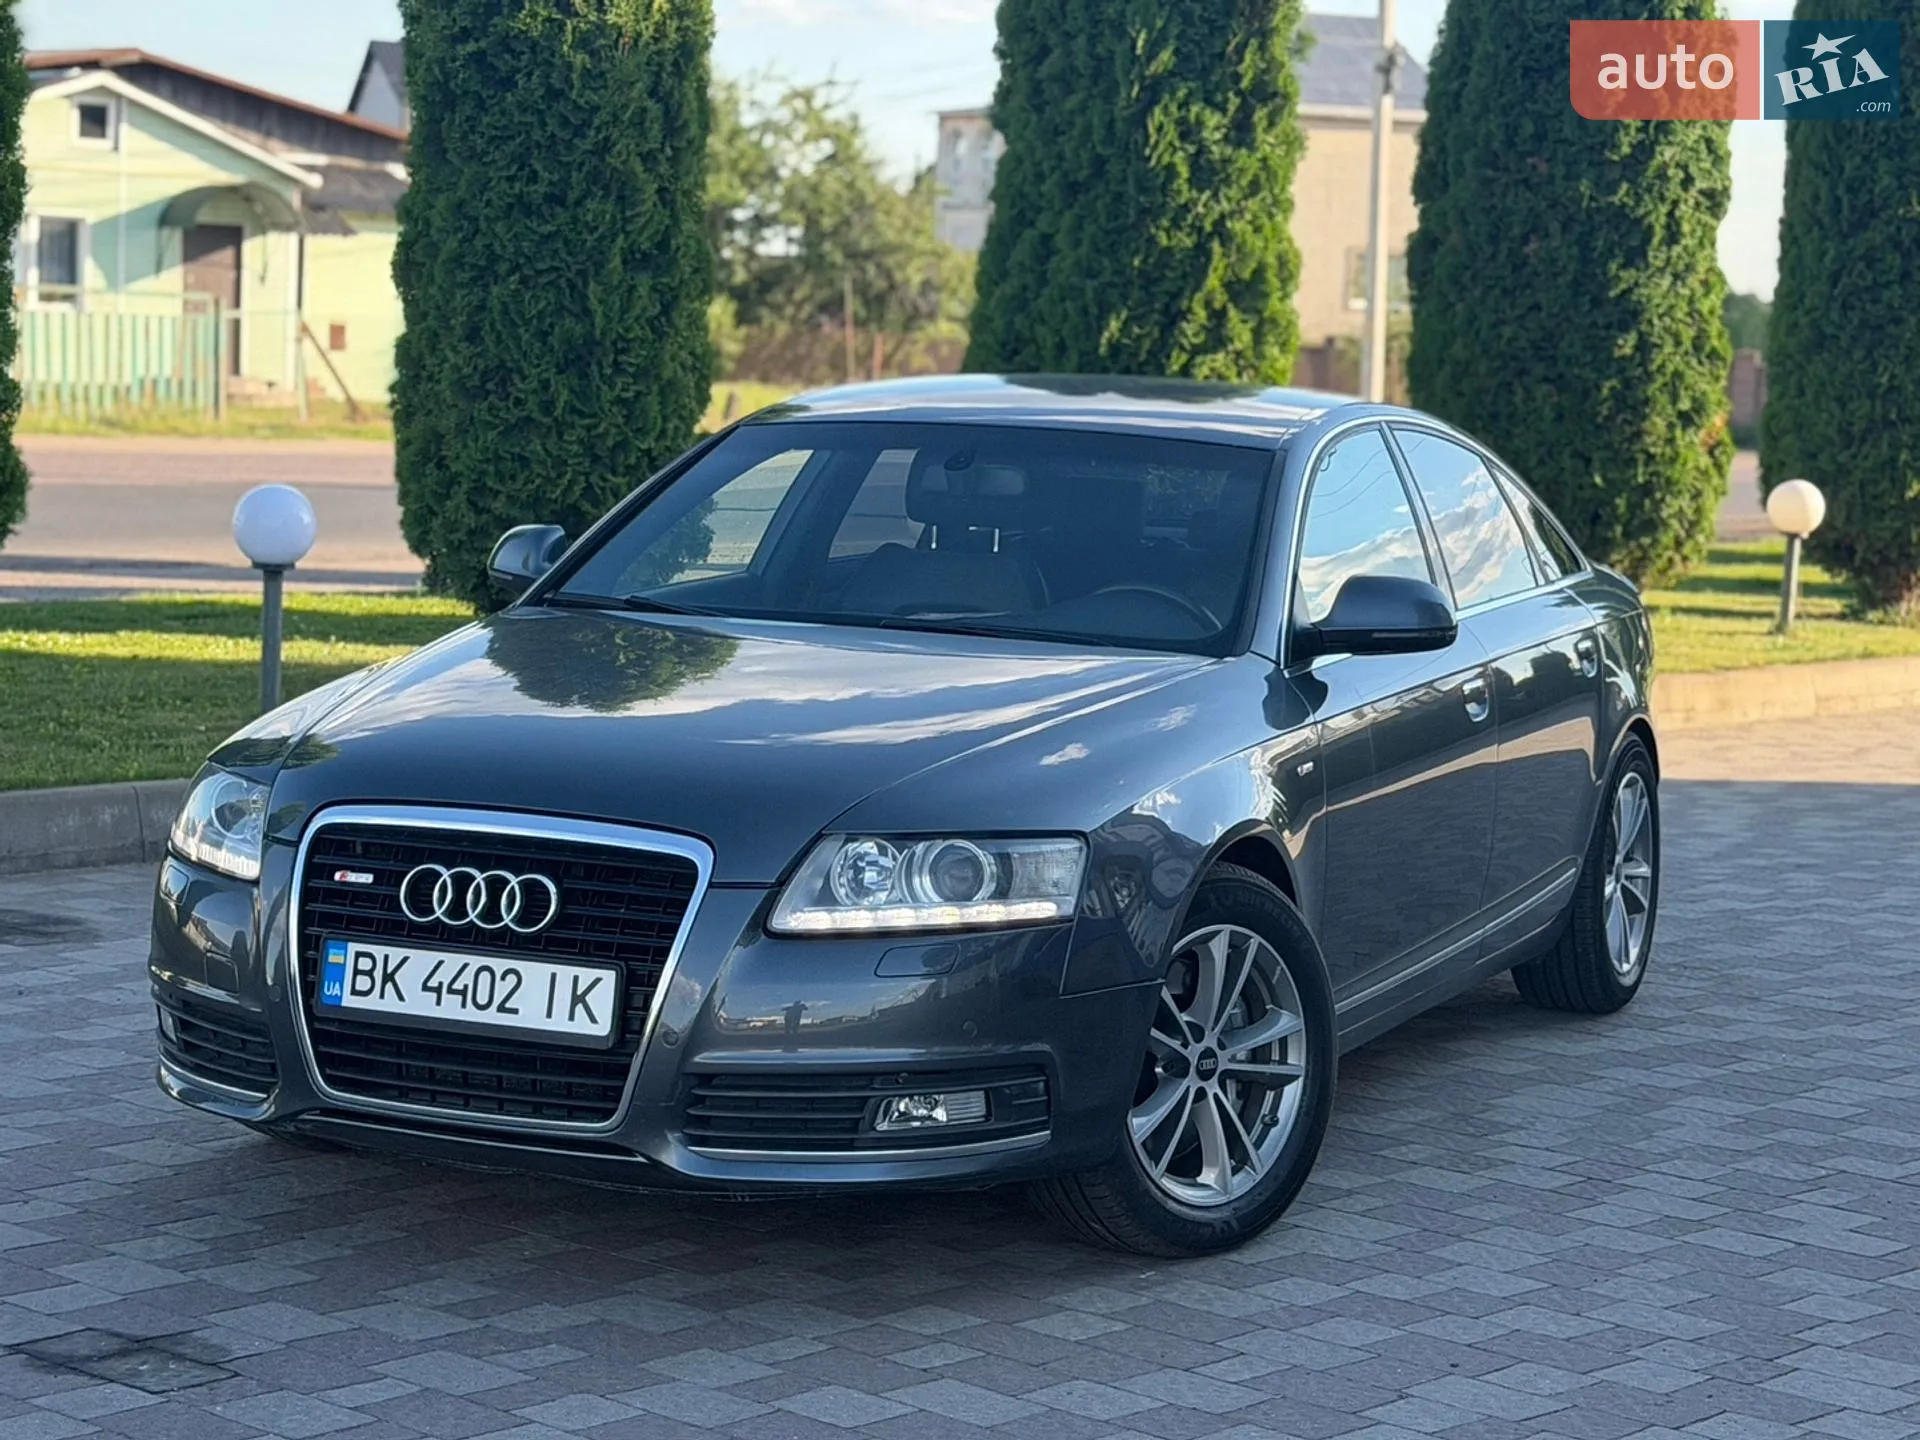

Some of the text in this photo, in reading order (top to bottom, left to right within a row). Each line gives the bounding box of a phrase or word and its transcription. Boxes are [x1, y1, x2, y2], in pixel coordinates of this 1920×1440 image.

[324, 981, 341, 997] UA
[350, 950, 603, 1025] BK 4402 IK
